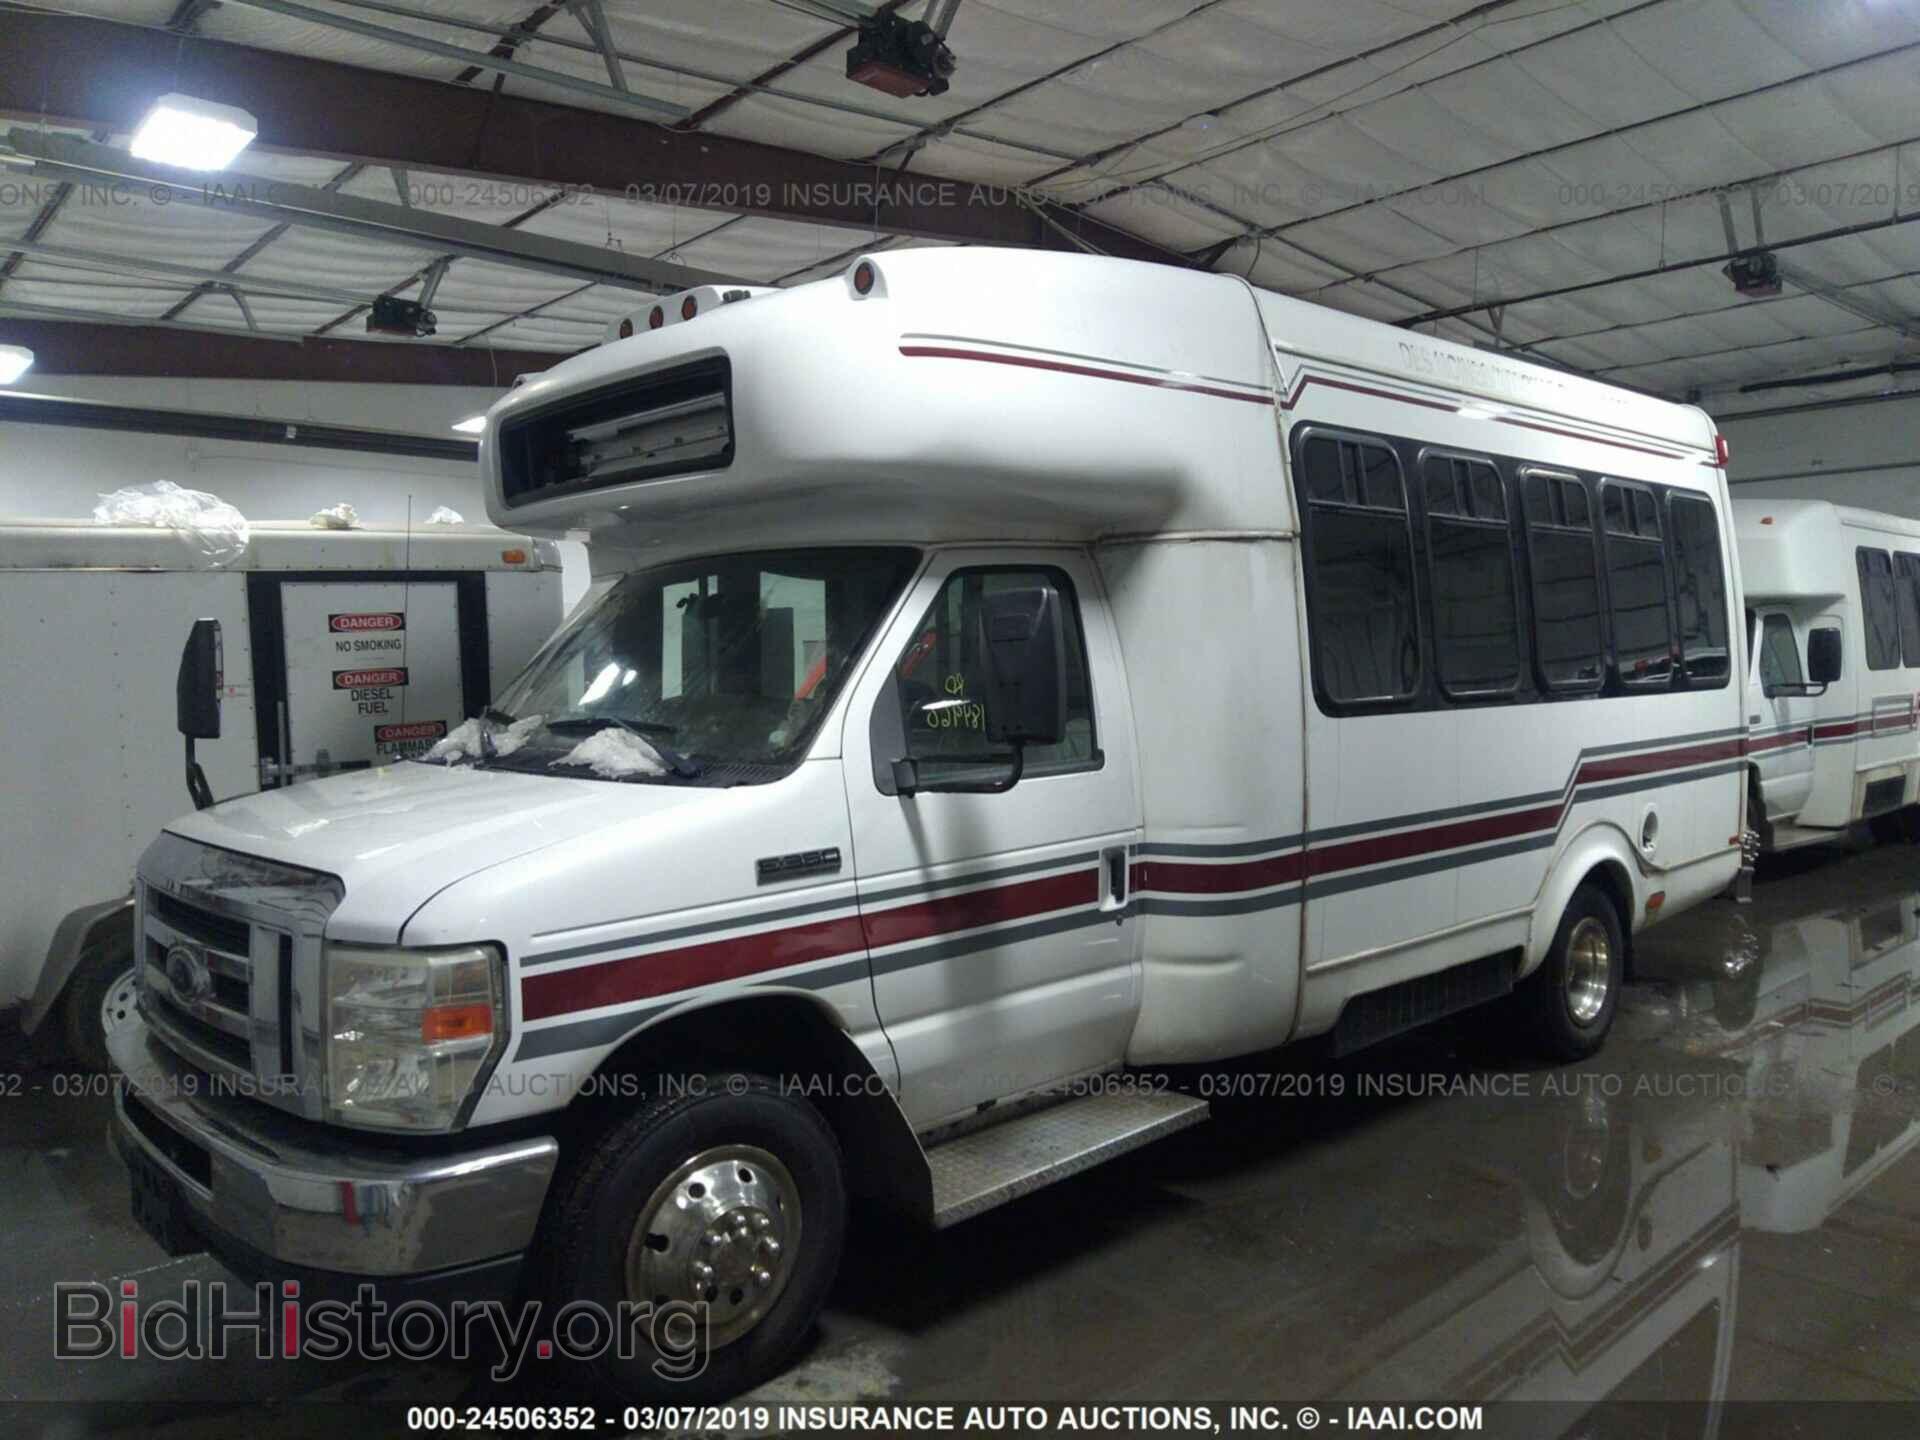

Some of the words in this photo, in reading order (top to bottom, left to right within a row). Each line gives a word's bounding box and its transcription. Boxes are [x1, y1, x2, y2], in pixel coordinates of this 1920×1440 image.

[340, 617, 394, 628] DANGER
[336, 641, 350, 652] NO
[353, 639, 401, 651] SMOKING
[344, 673, 397, 685] DANGER
[351, 688, 394, 701] DIESEL
[358, 703, 389, 714] FUEL
[385, 726, 436, 738] DANGER
